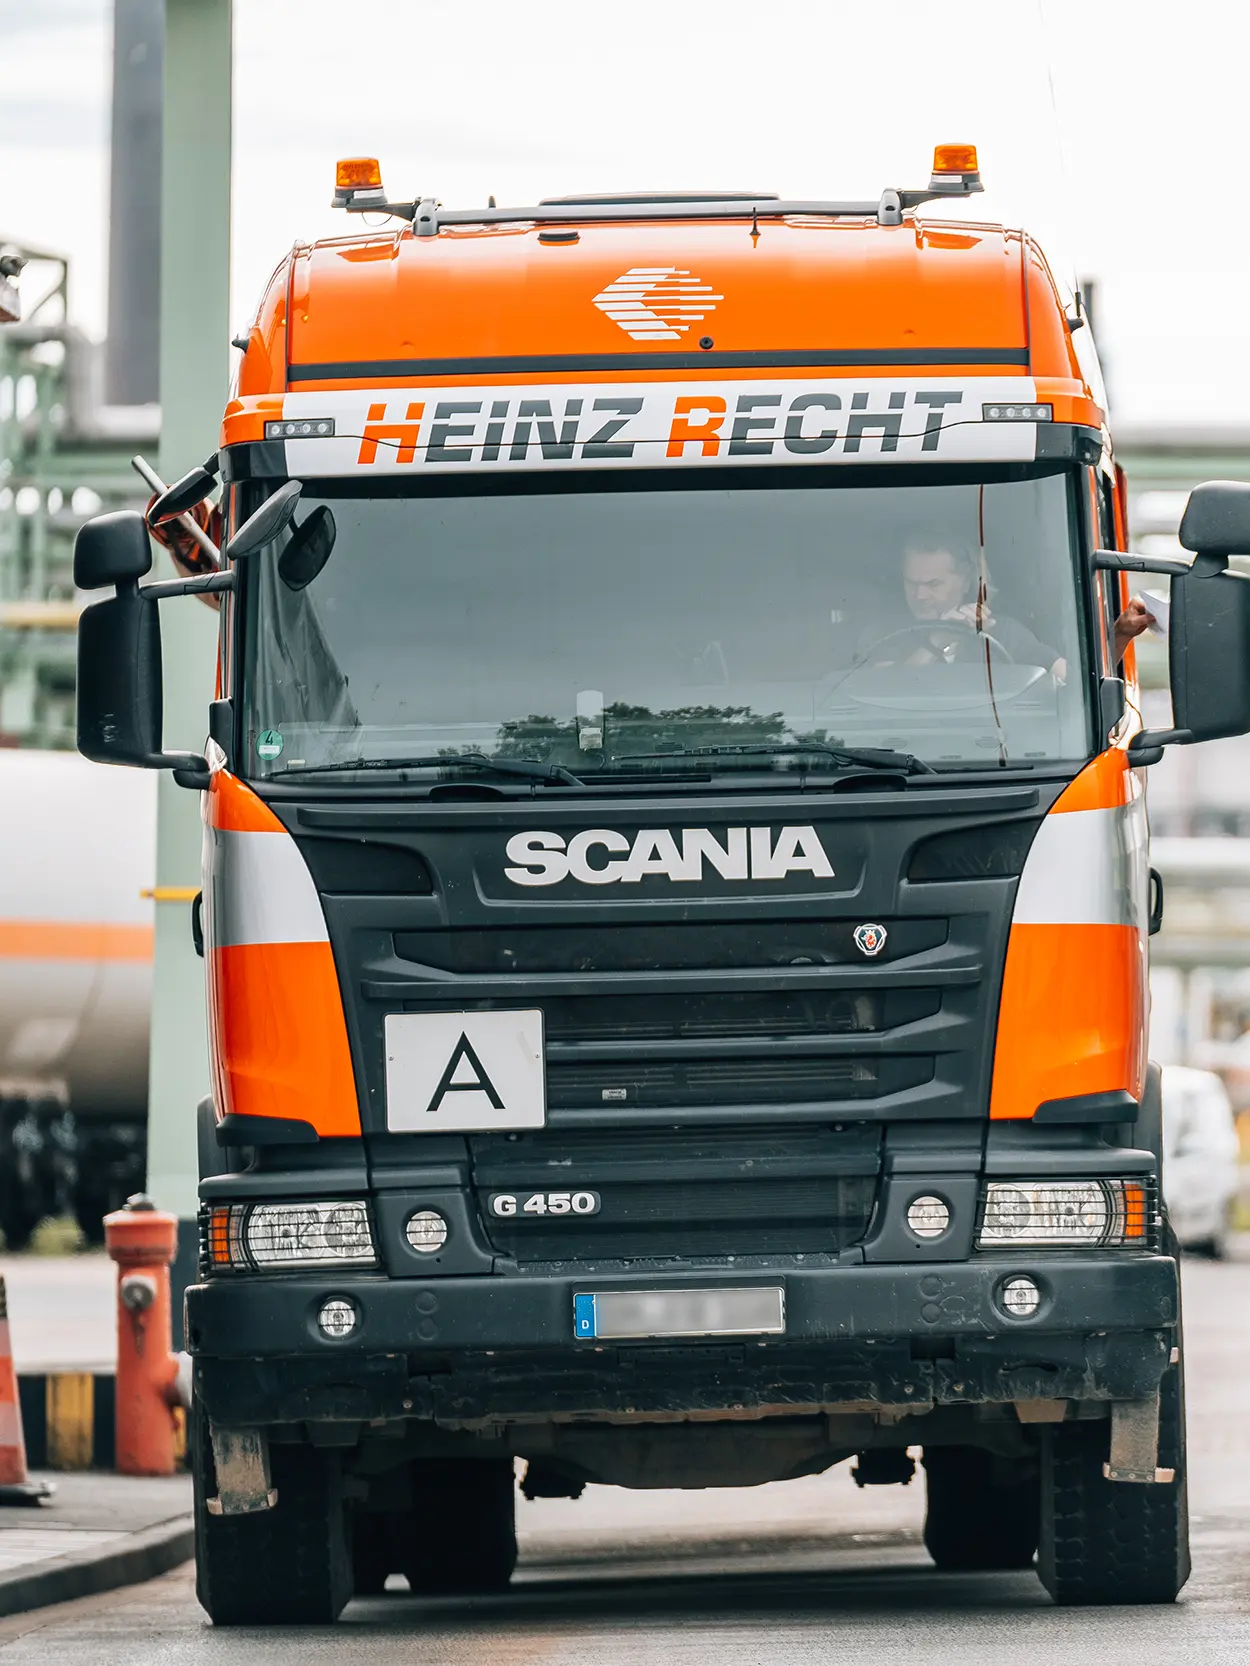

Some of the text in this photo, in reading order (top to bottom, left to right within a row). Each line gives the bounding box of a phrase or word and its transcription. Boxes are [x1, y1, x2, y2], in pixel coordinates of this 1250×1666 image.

[357, 391, 964, 464] HEINZ RECHT
[265, 730, 274, 745] 4
[504, 825, 835, 886] SCANIA
[426, 1031, 506, 1112] A
[493, 1192, 596, 1216] G 450
[581, 1319, 590, 1330] D
